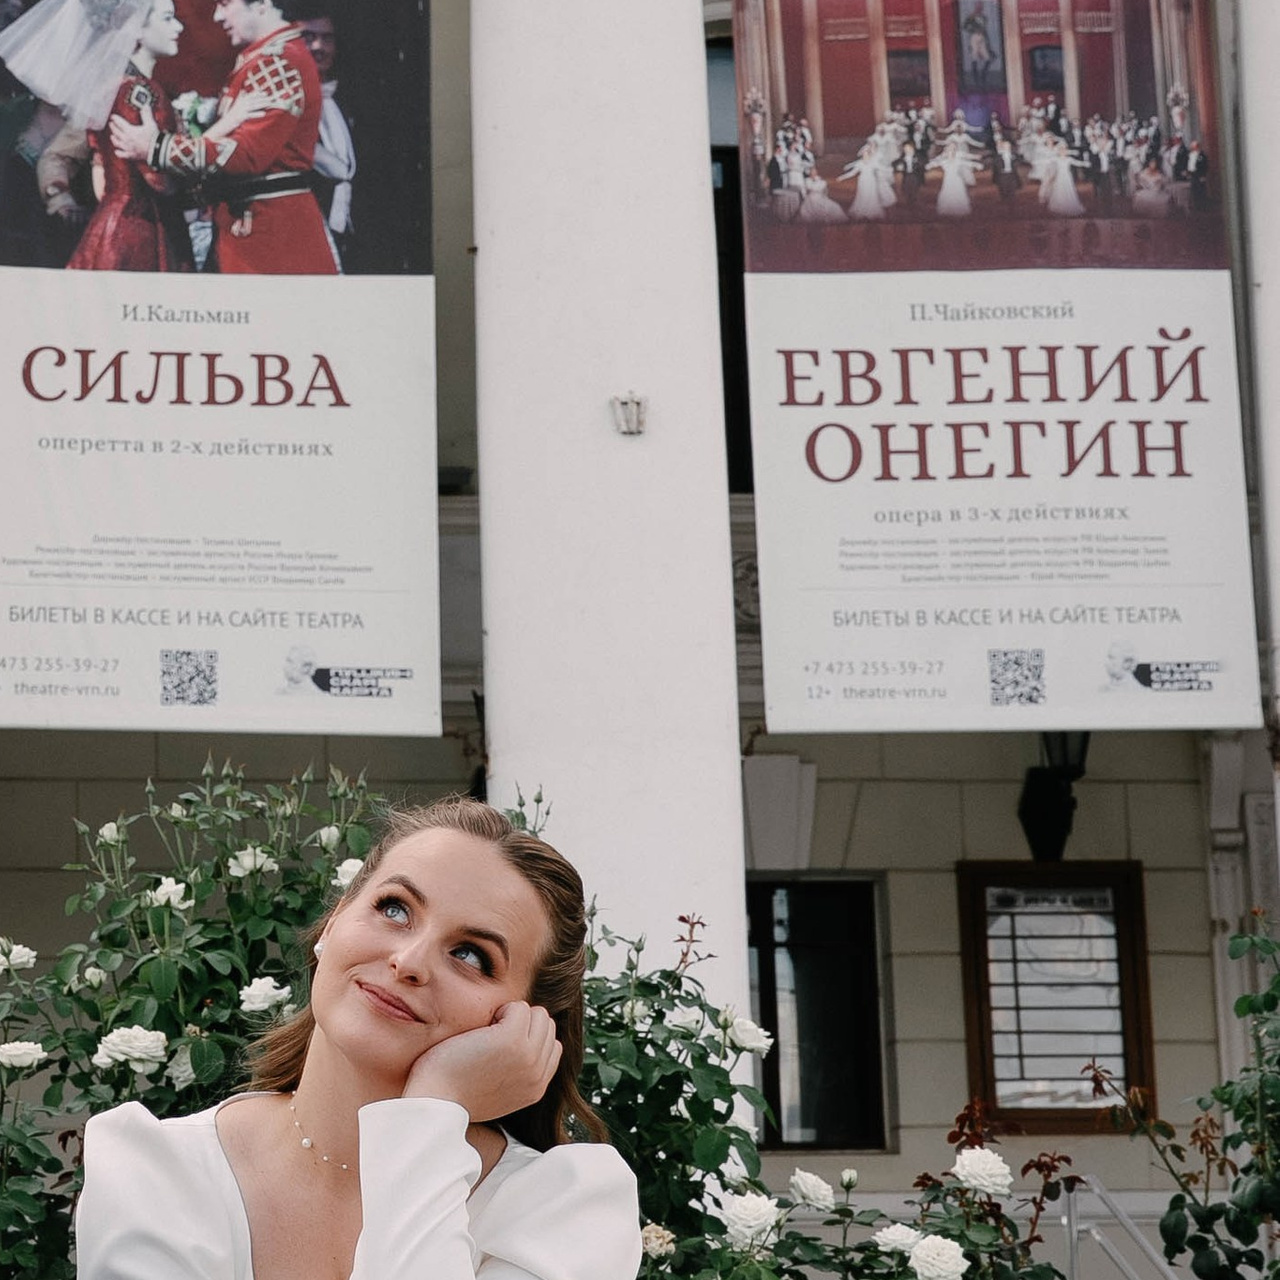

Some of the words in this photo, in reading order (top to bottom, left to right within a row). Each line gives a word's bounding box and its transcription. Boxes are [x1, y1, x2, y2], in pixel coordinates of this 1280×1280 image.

[122, 303, 251, 325] И.Кальман
[909, 300, 1075, 322] П.Чайковский
[22, 345, 351, 407] СИЛЬВА
[776, 326, 1210, 407] ЕВГЕНИЙ
[37, 435, 145, 456] оперетта
[152, 440, 164, 453] в
[170, 440, 204, 454] 2-х
[208, 438, 335, 457] действиях
[805, 420, 1193, 483] ОНЕГИН
[873, 506, 942, 527] опера
[950, 507, 962, 521] в
[969, 506, 1002, 521] 3-х
[1006, 502, 1131, 524] действиях
[8, 605, 88, 624] БИЛЕТЫ
[94, 607, 106, 624] В
[111, 607, 171, 626] КАССЕ
[177, 609, 191, 625] И
[197, 610, 224, 626] НА
[228, 607, 289, 628] САЙТЕ
[295, 611, 365, 629] ТЕАТРА
[832, 609, 910, 627] БИЛЕТЫ
[916, 608, 928, 626] В
[934, 608, 991, 626] КАССЕ
[999, 608, 1013, 625] И
[1019, 607, 1045, 625] НА
[1049, 604, 1110, 625] САЙТЕ
[1115, 606, 1183, 625] ТЕАТРА
[14, 681, 121, 697] theatre-vrn.ru
[842, 685, 947, 700] theatre-vrn.ru
